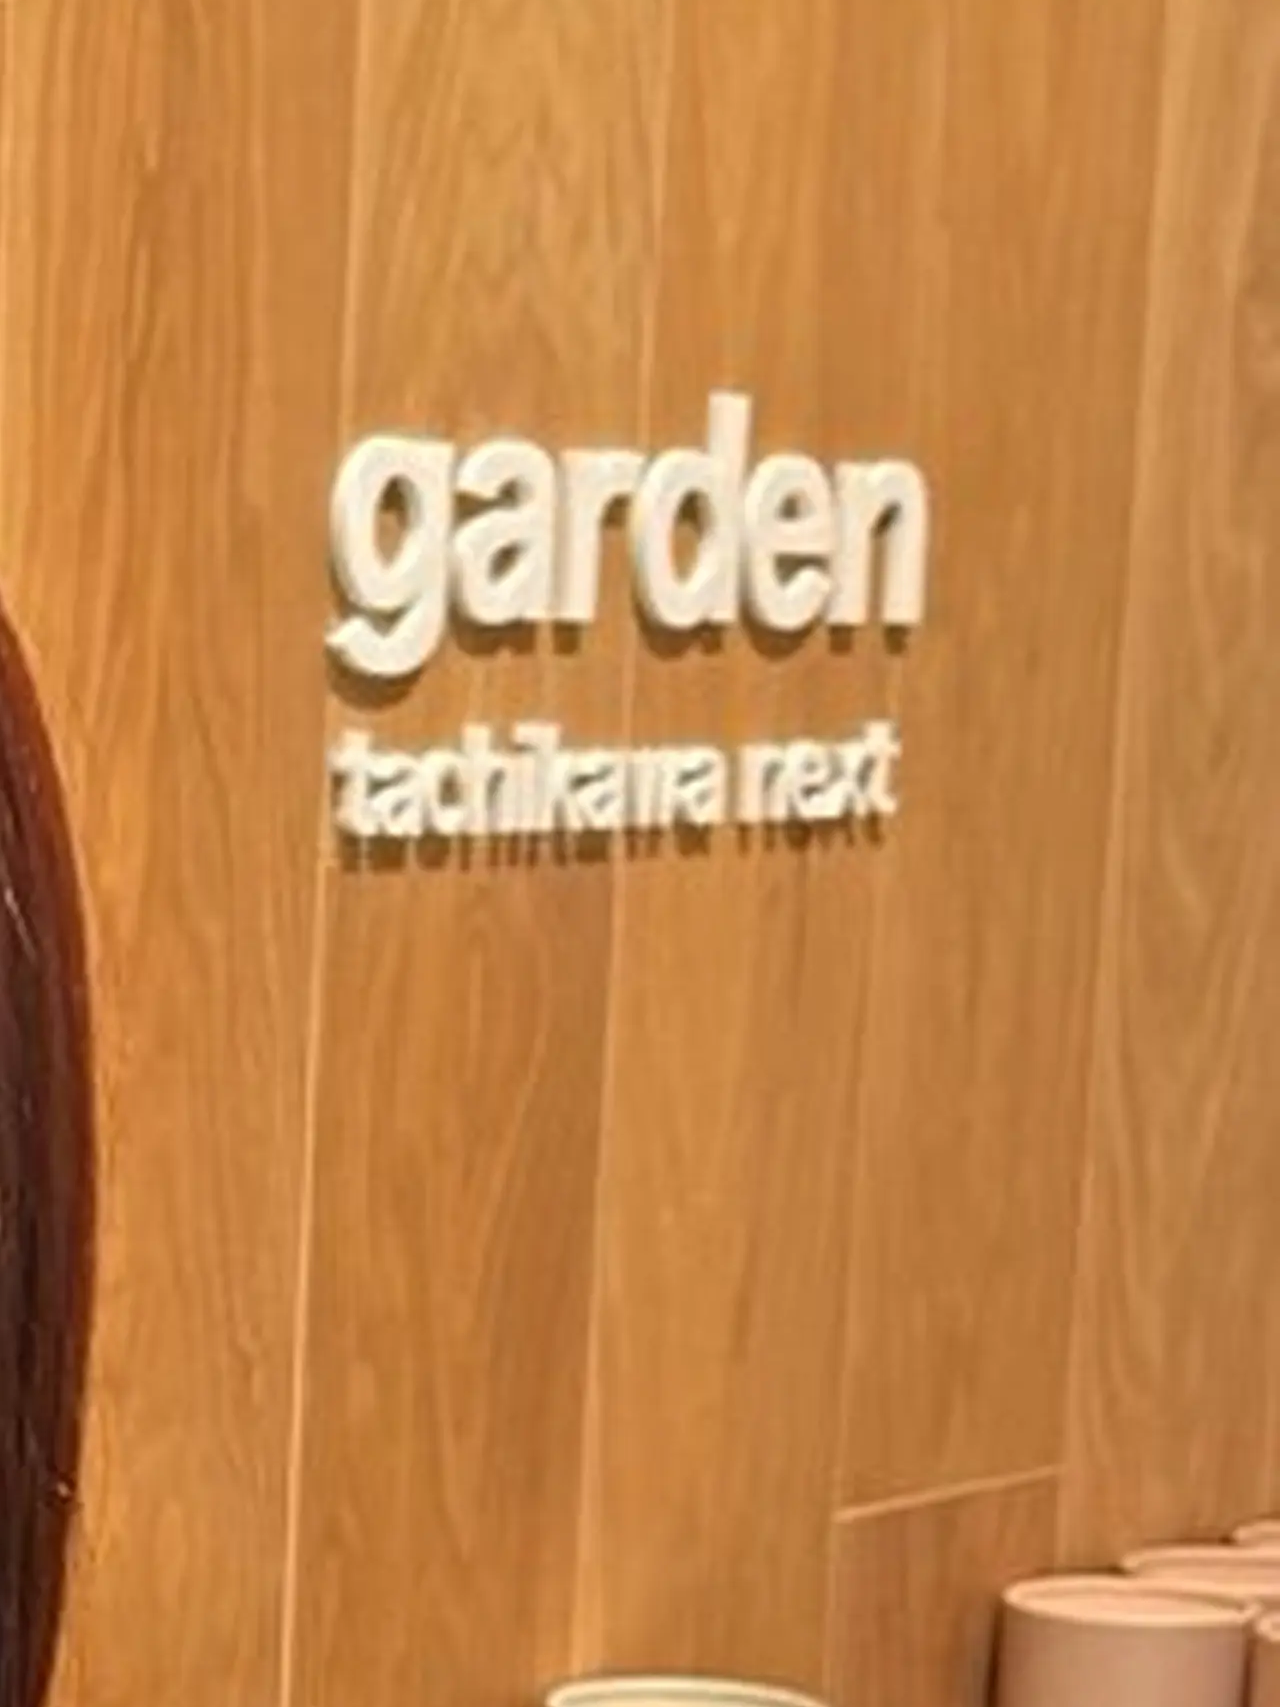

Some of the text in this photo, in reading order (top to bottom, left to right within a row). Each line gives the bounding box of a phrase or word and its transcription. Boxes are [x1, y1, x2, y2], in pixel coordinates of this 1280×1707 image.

[326, 392, 928, 675] garden
[332, 721, 902, 838] tachikawa next
